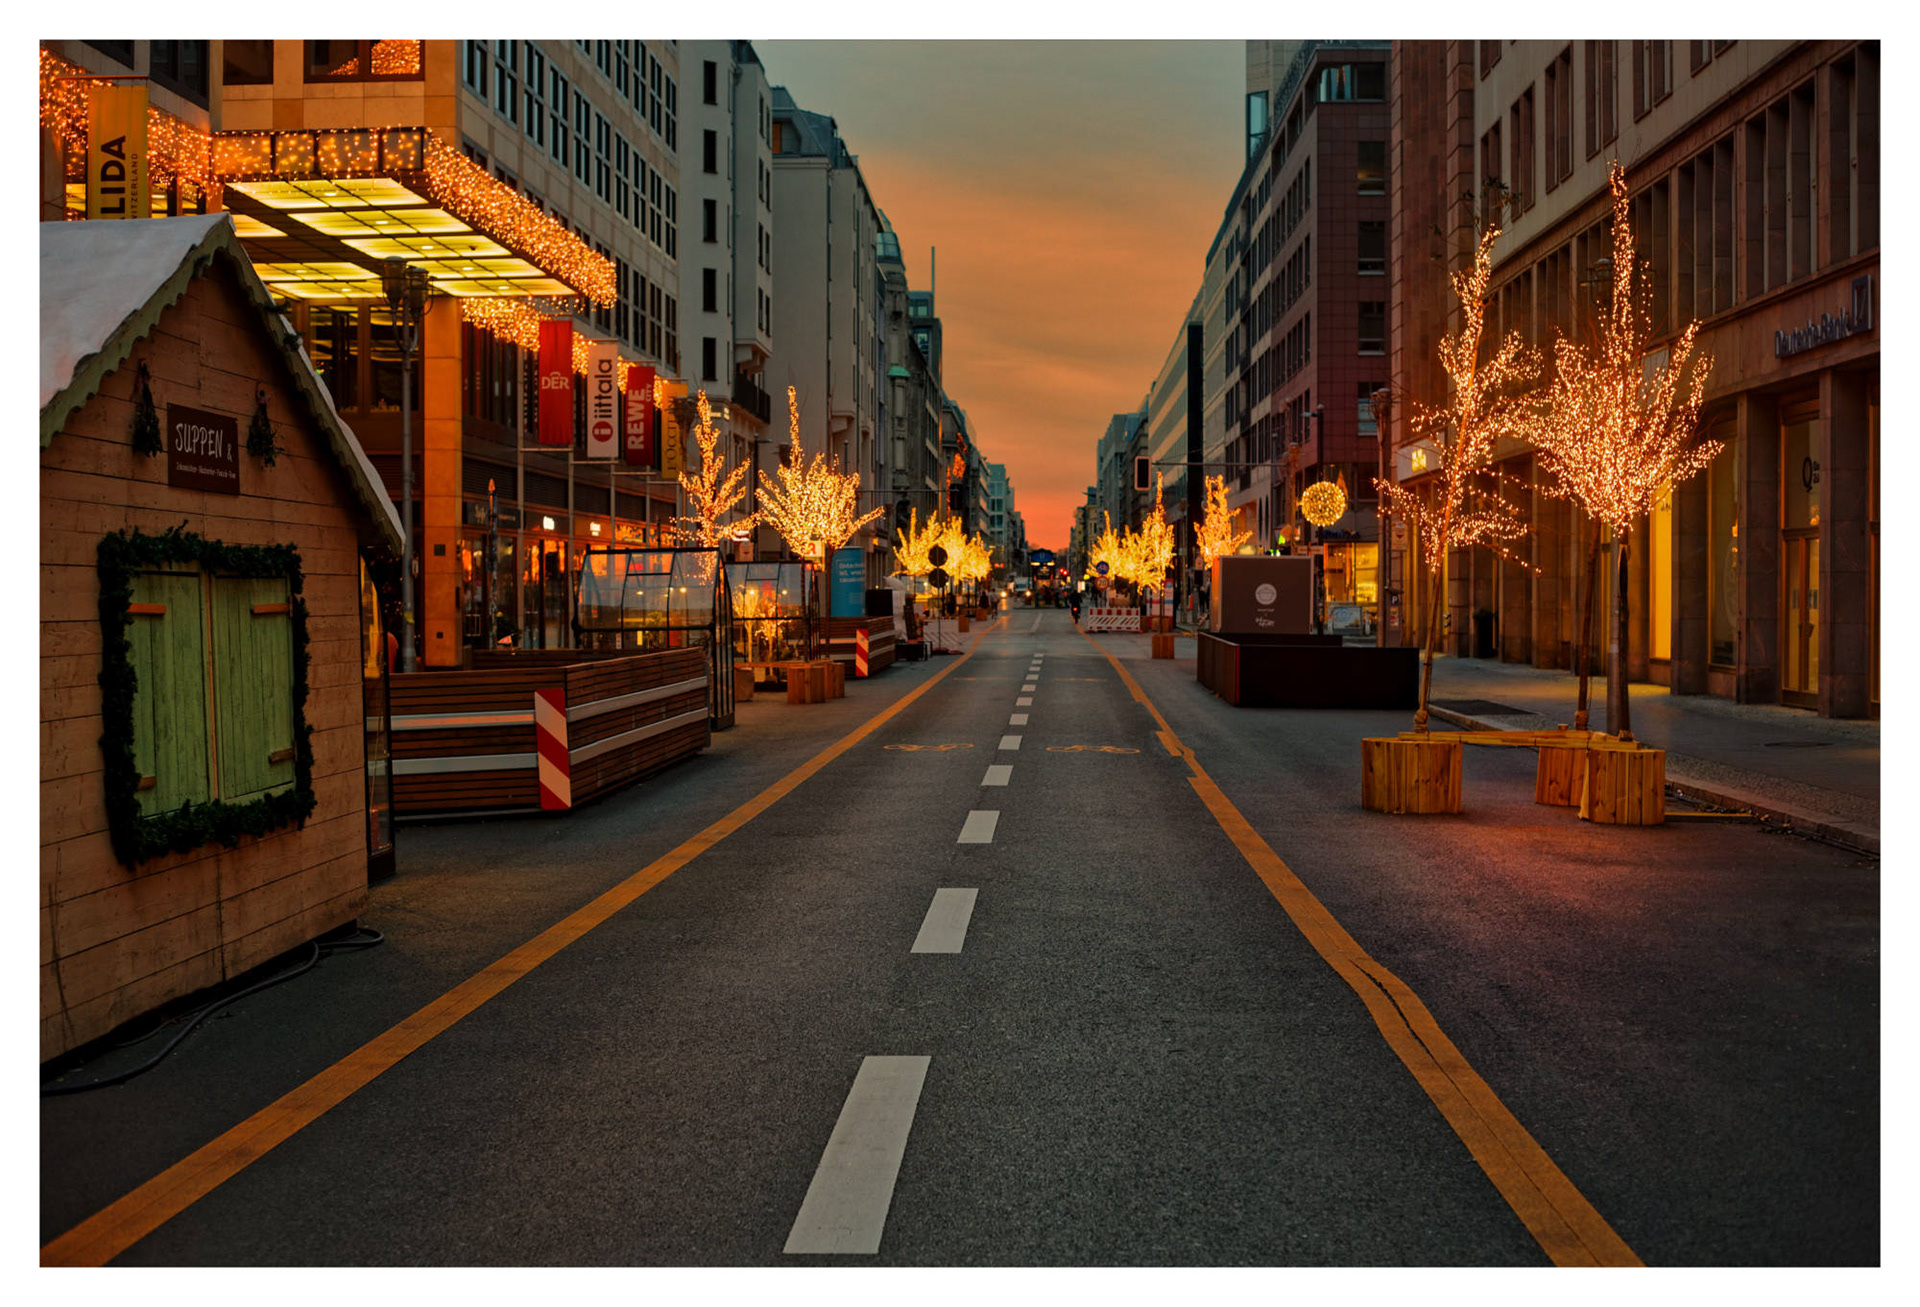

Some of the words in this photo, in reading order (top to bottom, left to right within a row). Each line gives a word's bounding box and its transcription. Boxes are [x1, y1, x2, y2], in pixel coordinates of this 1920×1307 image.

[101, 135, 126, 219] LIDA
[1775, 318, 1821, 359] Deutsche
[1821, 306, 1851, 343] Bank
[541, 374, 570, 390] DER
[594, 359, 612, 419] iittala
[645, 384, 653, 402] CITY
[174, 422, 224, 460] SUPPEN
[226, 442, 234, 463] &
[627, 388, 645, 450] REWE
[1392, 596, 1398, 604] P
